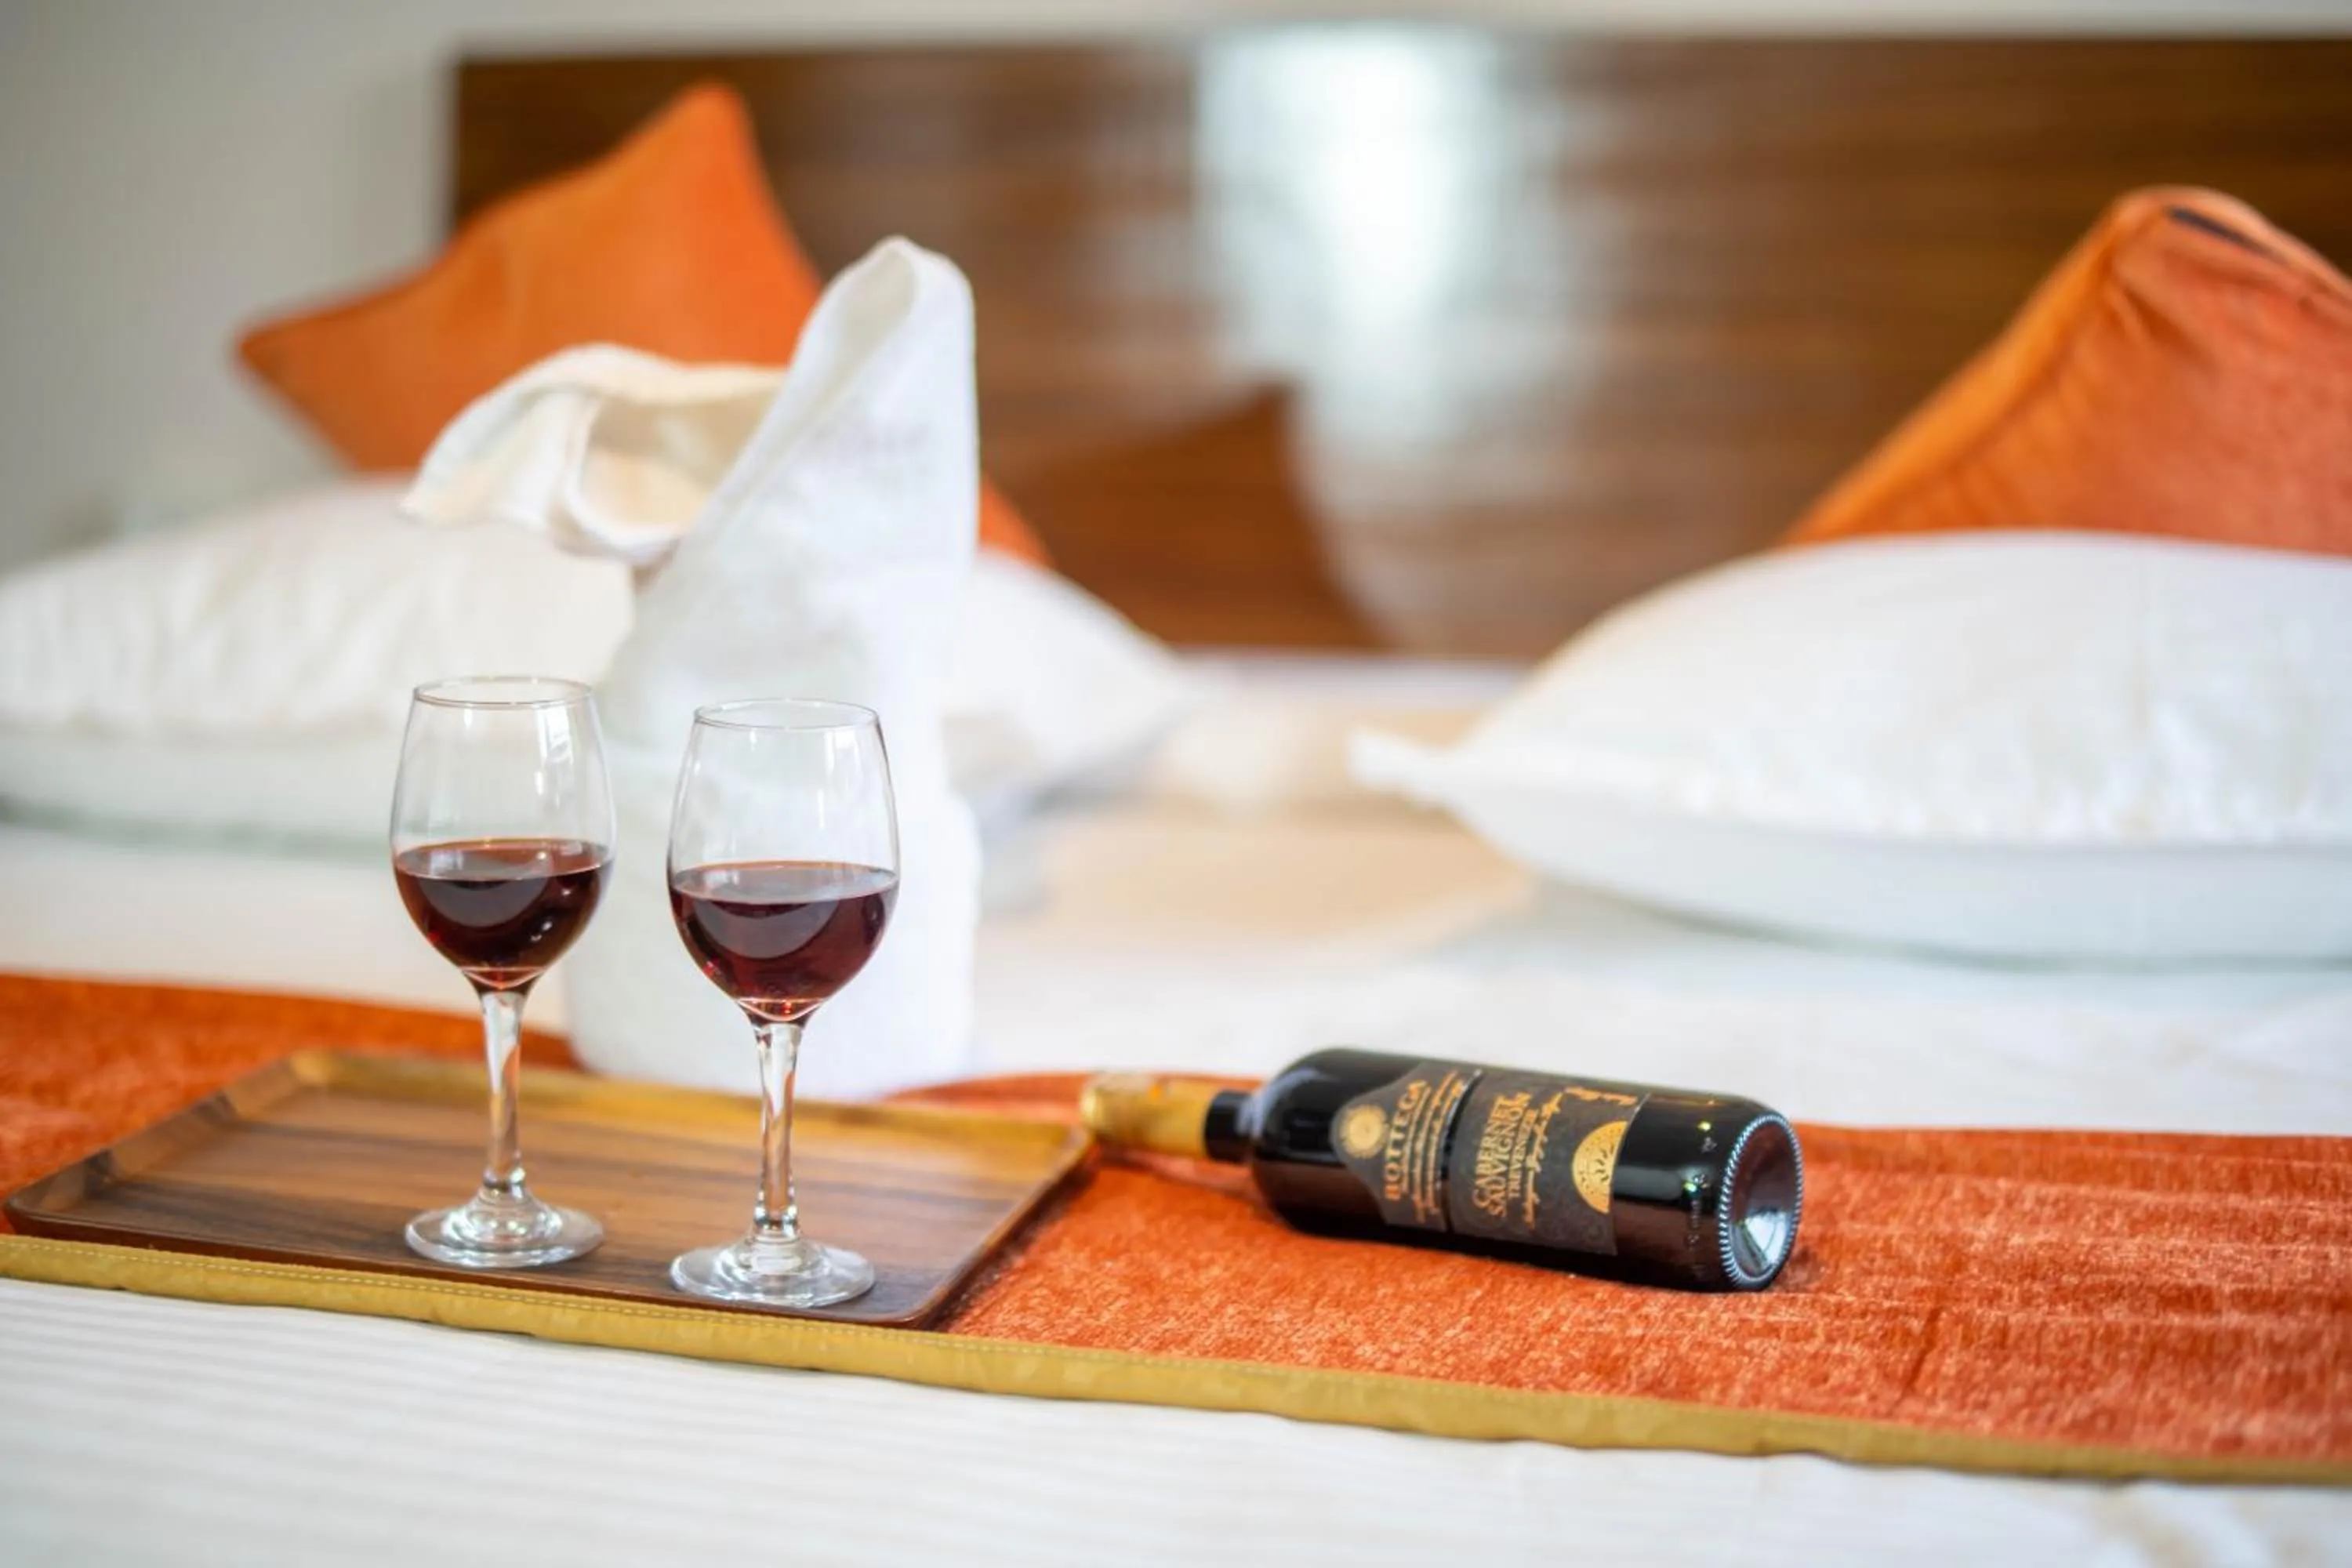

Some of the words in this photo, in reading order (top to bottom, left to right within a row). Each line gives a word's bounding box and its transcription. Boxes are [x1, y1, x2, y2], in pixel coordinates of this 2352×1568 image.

[1385, 1080, 1429, 1203] BOTTEGA
[1472, 1094, 1516, 1210] CABERNET
[1487, 1092, 1531, 1218] SAUVIGNON
